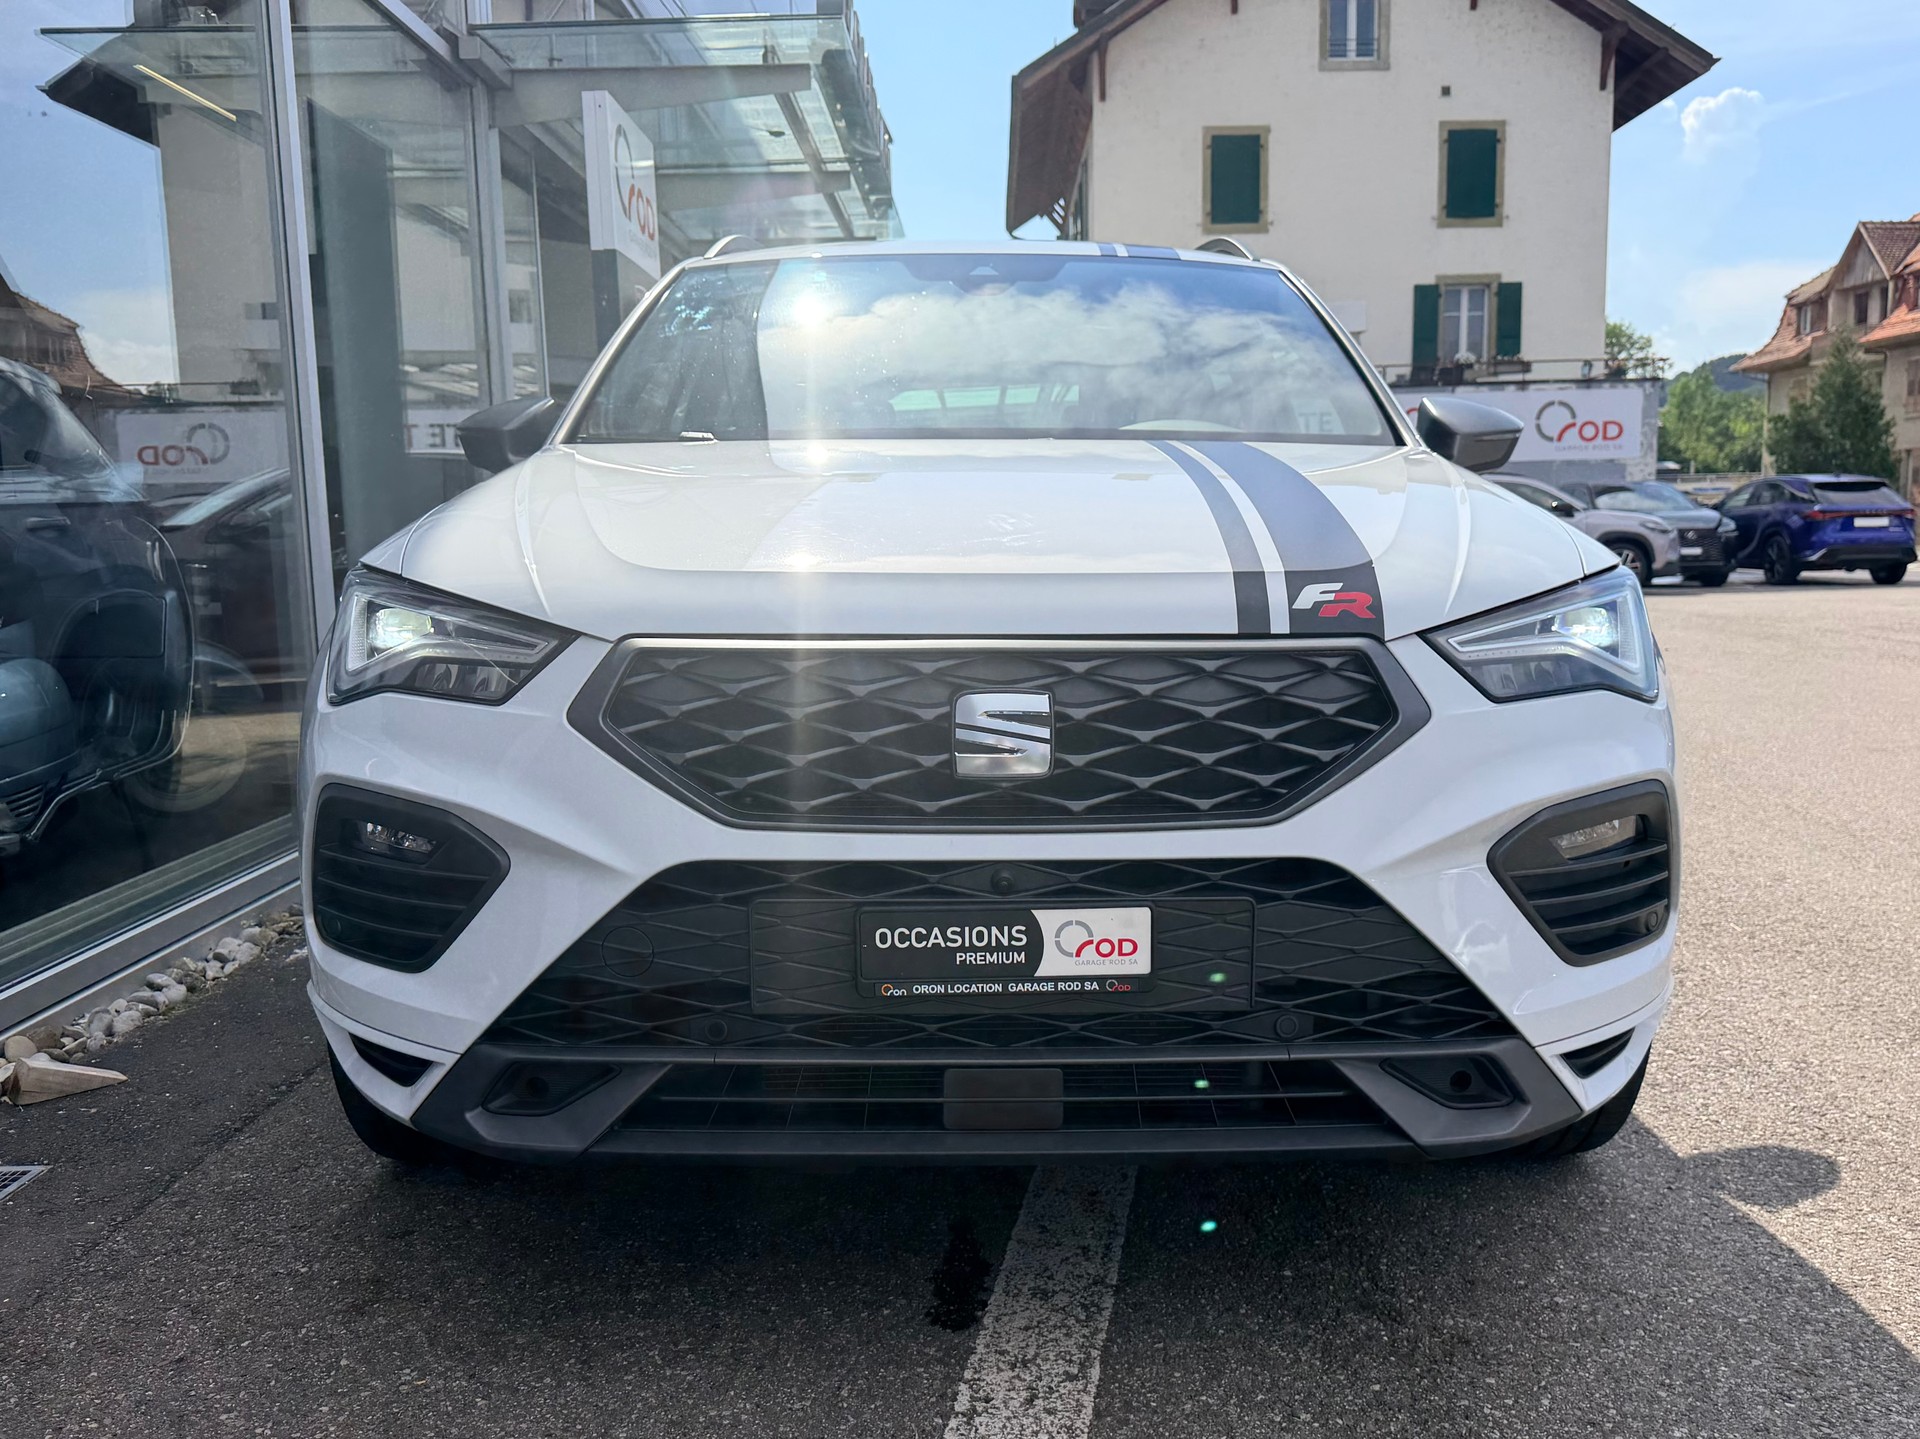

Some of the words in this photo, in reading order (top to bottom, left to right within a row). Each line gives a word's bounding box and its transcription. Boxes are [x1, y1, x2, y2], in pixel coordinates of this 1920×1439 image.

[1292, 582, 1377, 619] FR
[874, 925, 1028, 949] OCCASIONS
[956, 952, 1026, 965] PREMIUM
[912, 984, 946, 994] ORON
[948, 983, 1003, 994] LOCATION
[1008, 982, 1055, 992] GARAGE
[1058, 981, 1082, 992] ROD
[1084, 981, 1099, 991] SA
